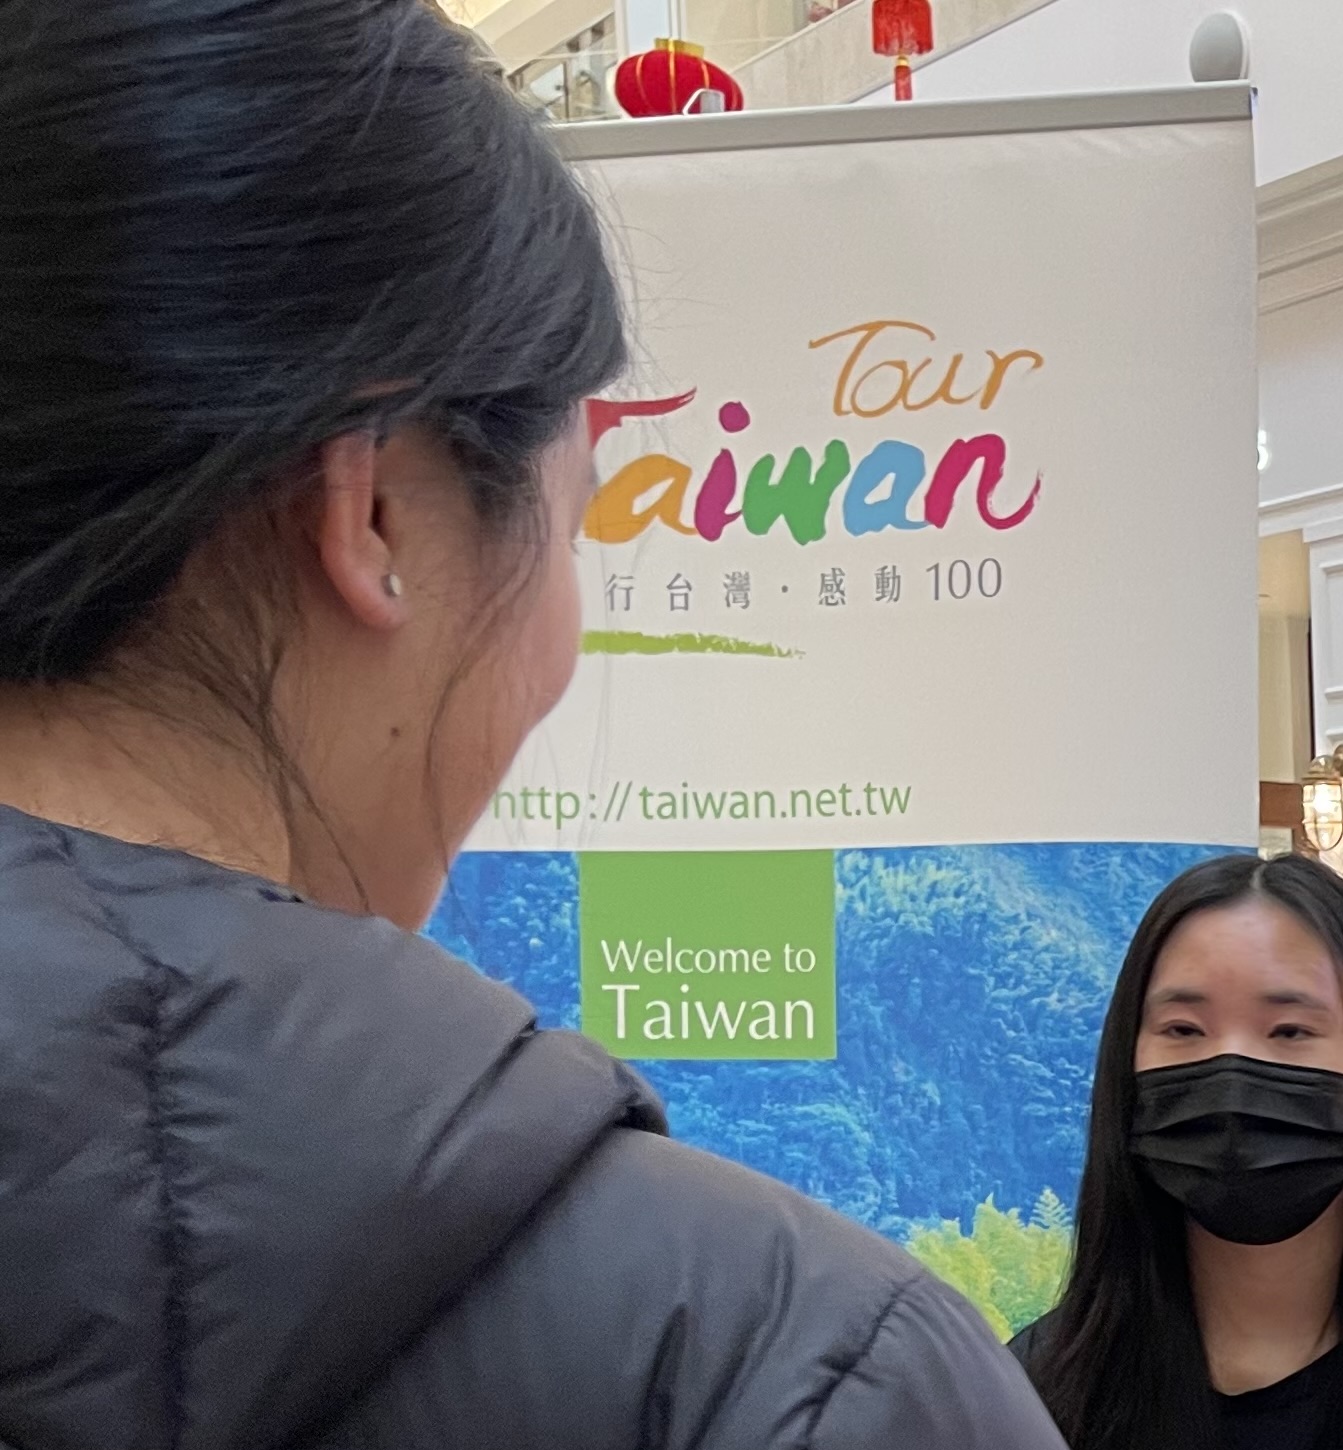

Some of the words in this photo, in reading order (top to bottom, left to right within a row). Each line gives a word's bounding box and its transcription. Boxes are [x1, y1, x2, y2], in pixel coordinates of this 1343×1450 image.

[808, 320, 1043, 418] Tour
[601, 937, 772, 974] Welcome
[783, 943, 817, 974] to
[601, 983, 816, 1041] Taiwan
